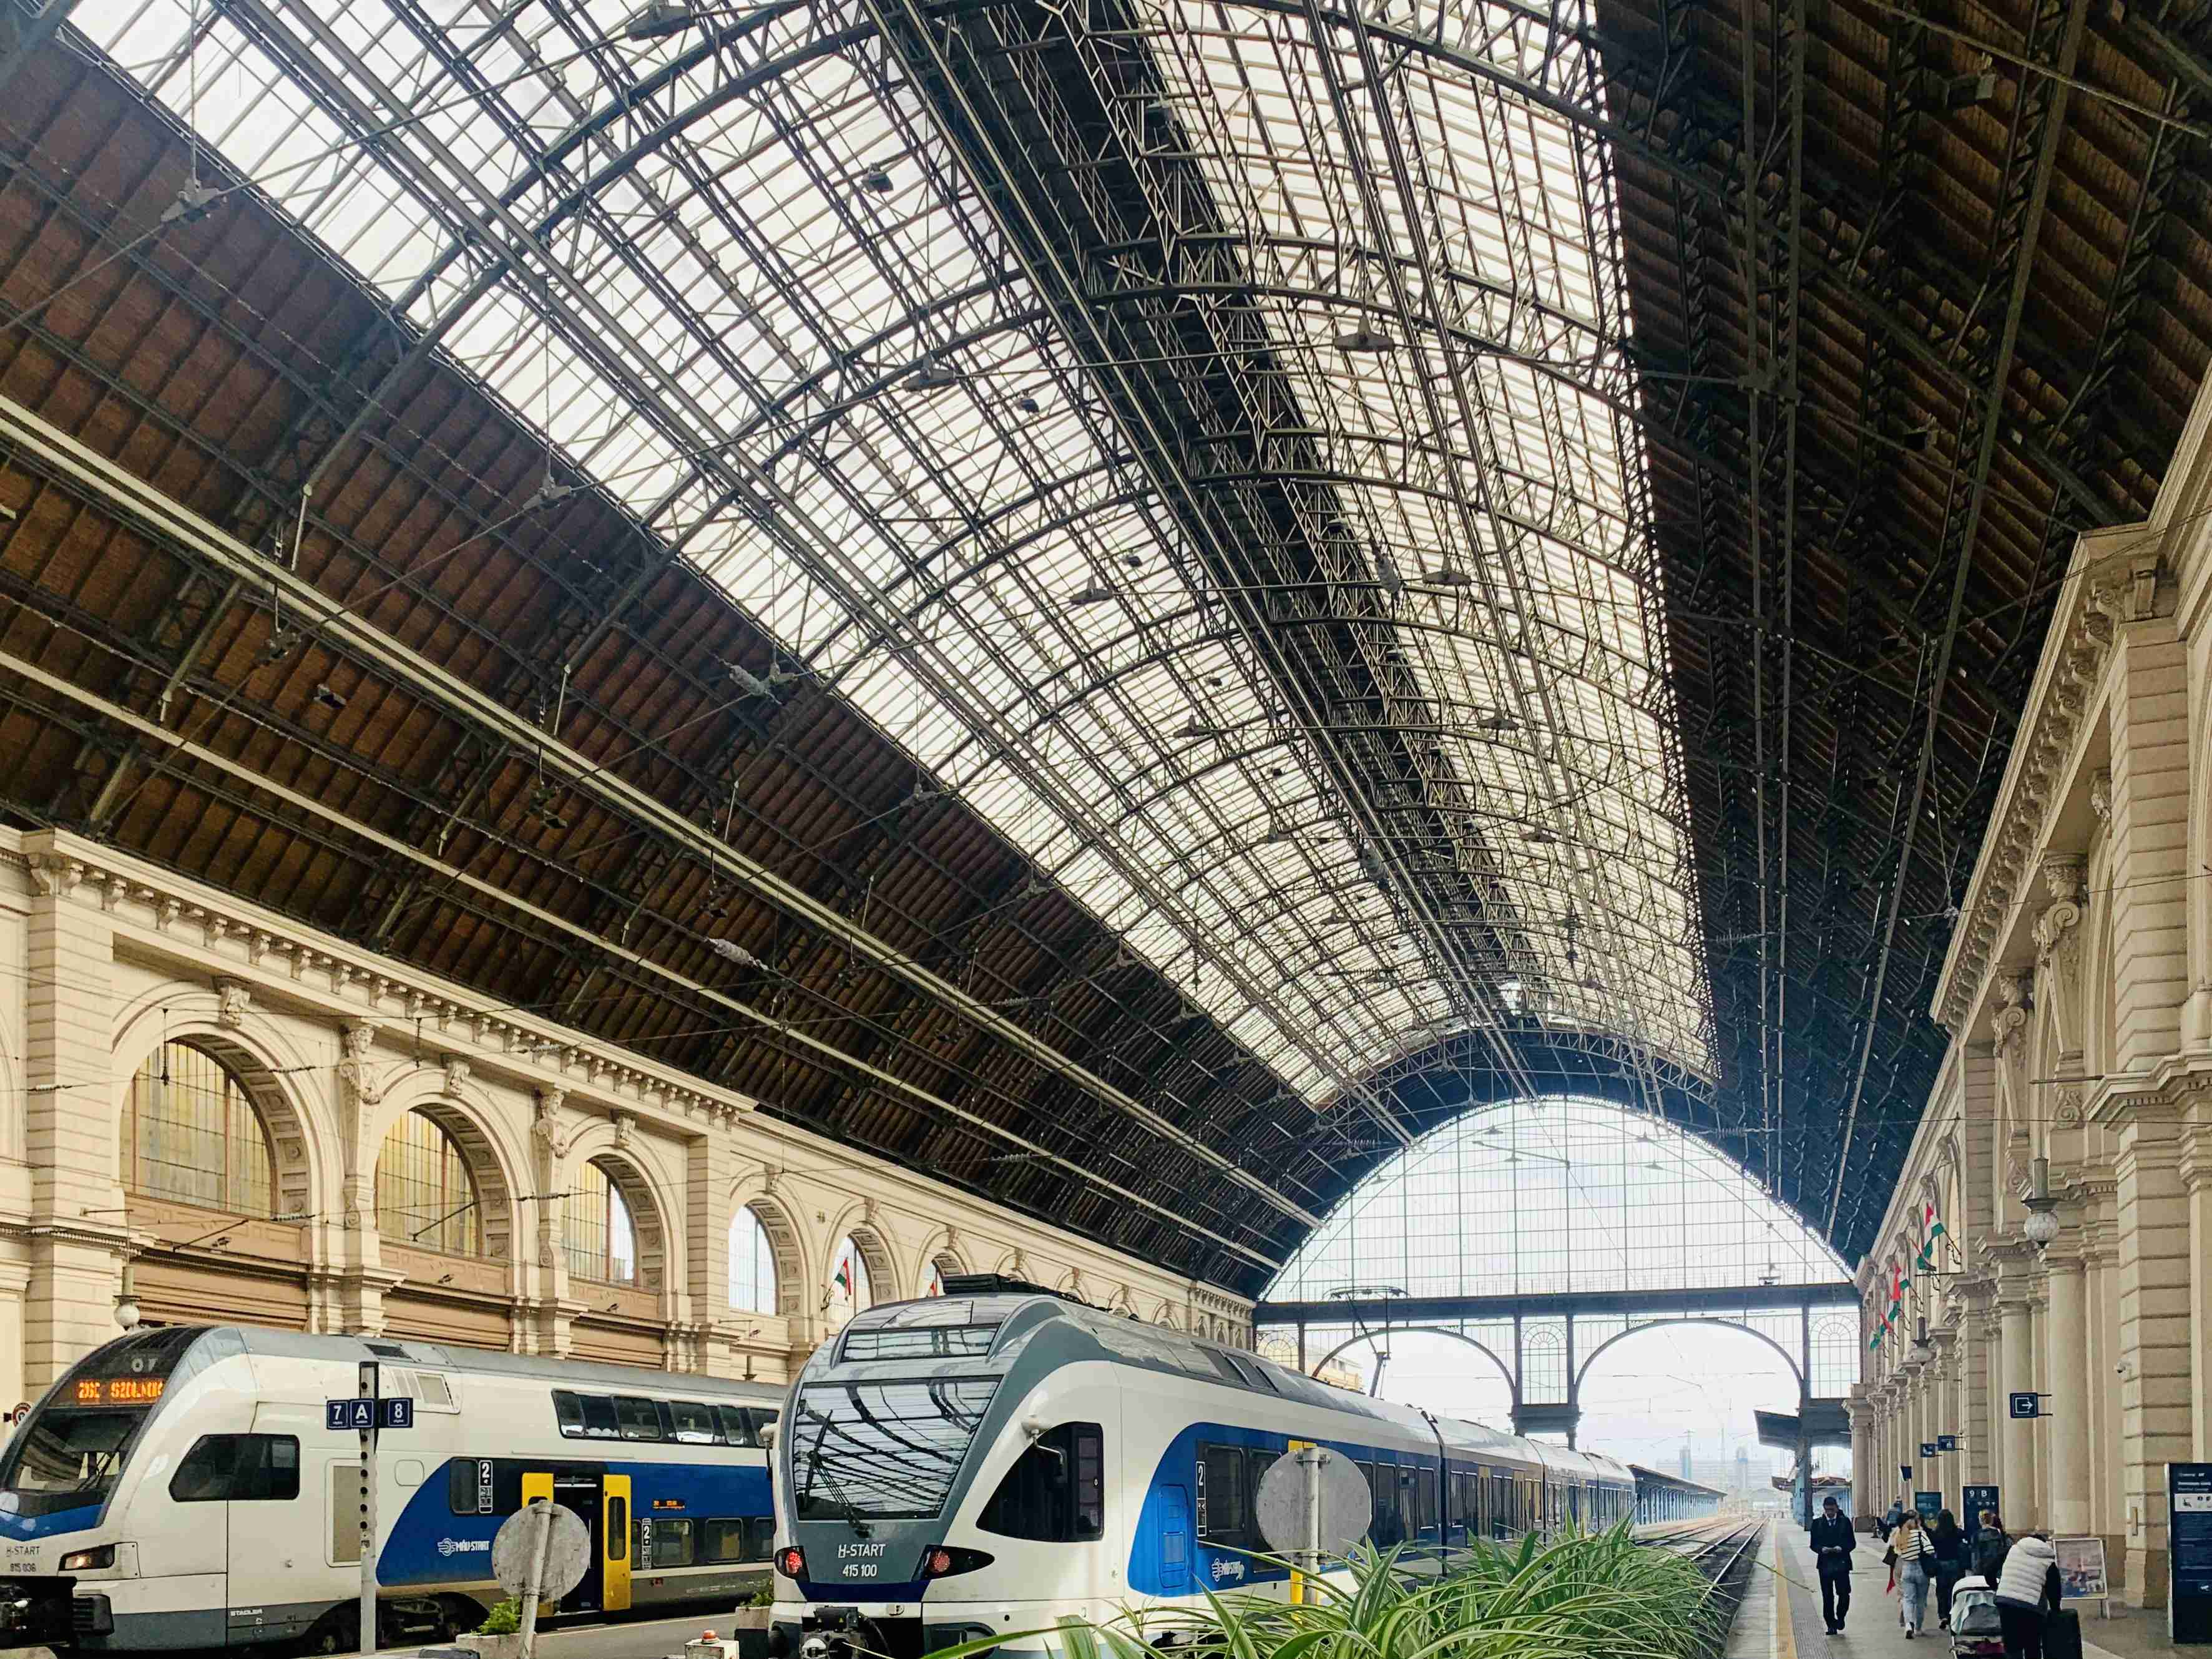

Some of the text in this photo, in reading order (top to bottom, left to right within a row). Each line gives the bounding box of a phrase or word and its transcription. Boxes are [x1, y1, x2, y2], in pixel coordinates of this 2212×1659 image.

[333, 1405, 342, 1420] 7
[355, 1404, 368, 1419] A
[394, 1403, 403, 1419] 8
[482, 1462, 490, 1478] 2
[1198, 1464, 1203, 1486] 2
[644, 1525, 650, 1539] 2
[838, 1544, 886, 1558] H-START
[843, 1564, 877, 1577] 415 100
